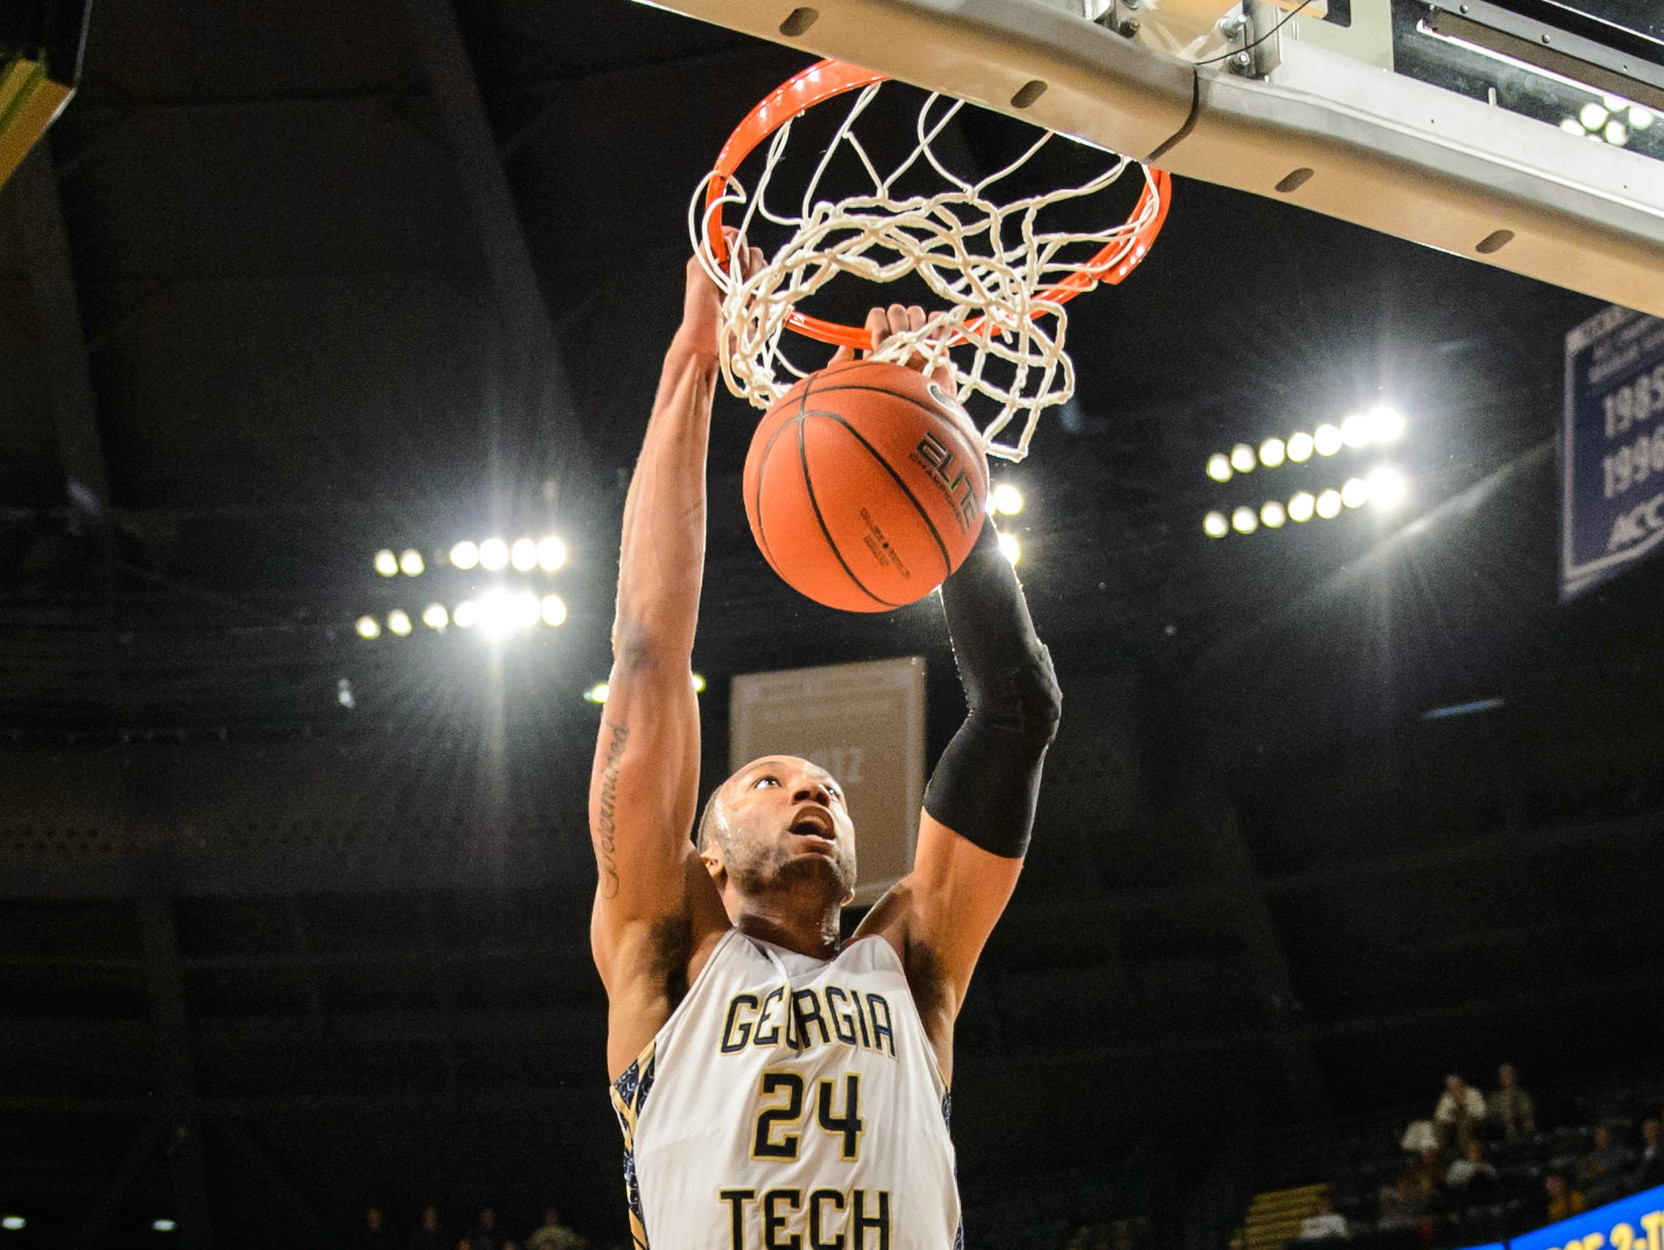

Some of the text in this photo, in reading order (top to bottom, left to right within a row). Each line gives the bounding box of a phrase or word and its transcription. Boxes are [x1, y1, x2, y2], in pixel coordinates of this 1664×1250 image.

[914, 430, 981, 533] ELITE
[720, 984, 897, 1060] GEORGIA
[751, 1070, 866, 1162] 24
